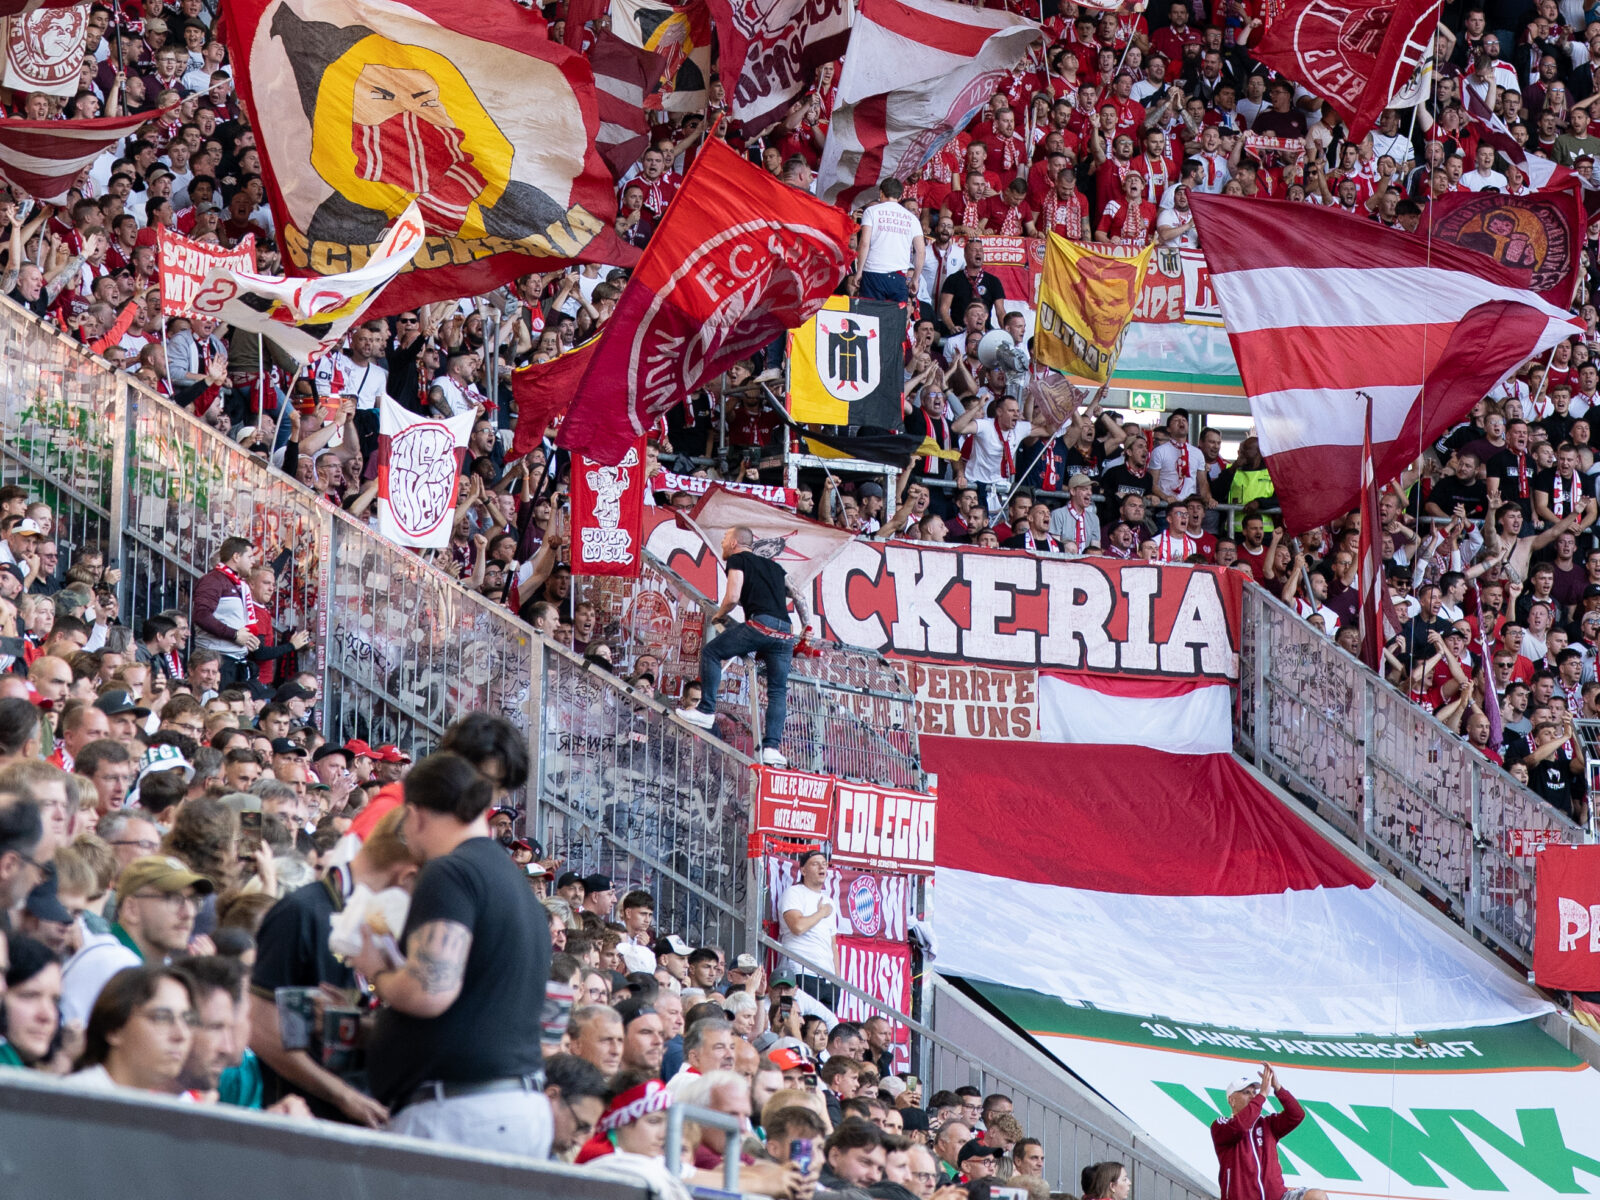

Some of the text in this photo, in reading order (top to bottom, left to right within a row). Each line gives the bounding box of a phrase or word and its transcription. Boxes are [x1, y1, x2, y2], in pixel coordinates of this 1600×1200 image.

[965, 704, 1031, 738] UNS
[771, 775, 828, 800] LOVE FC BAYERN
[791, 810, 816, 831] RACISM
[838, 789, 936, 863] COLEGIO
[1141, 1022, 1484, 1059] 10 JAHRE PARTNERSCHAFT
